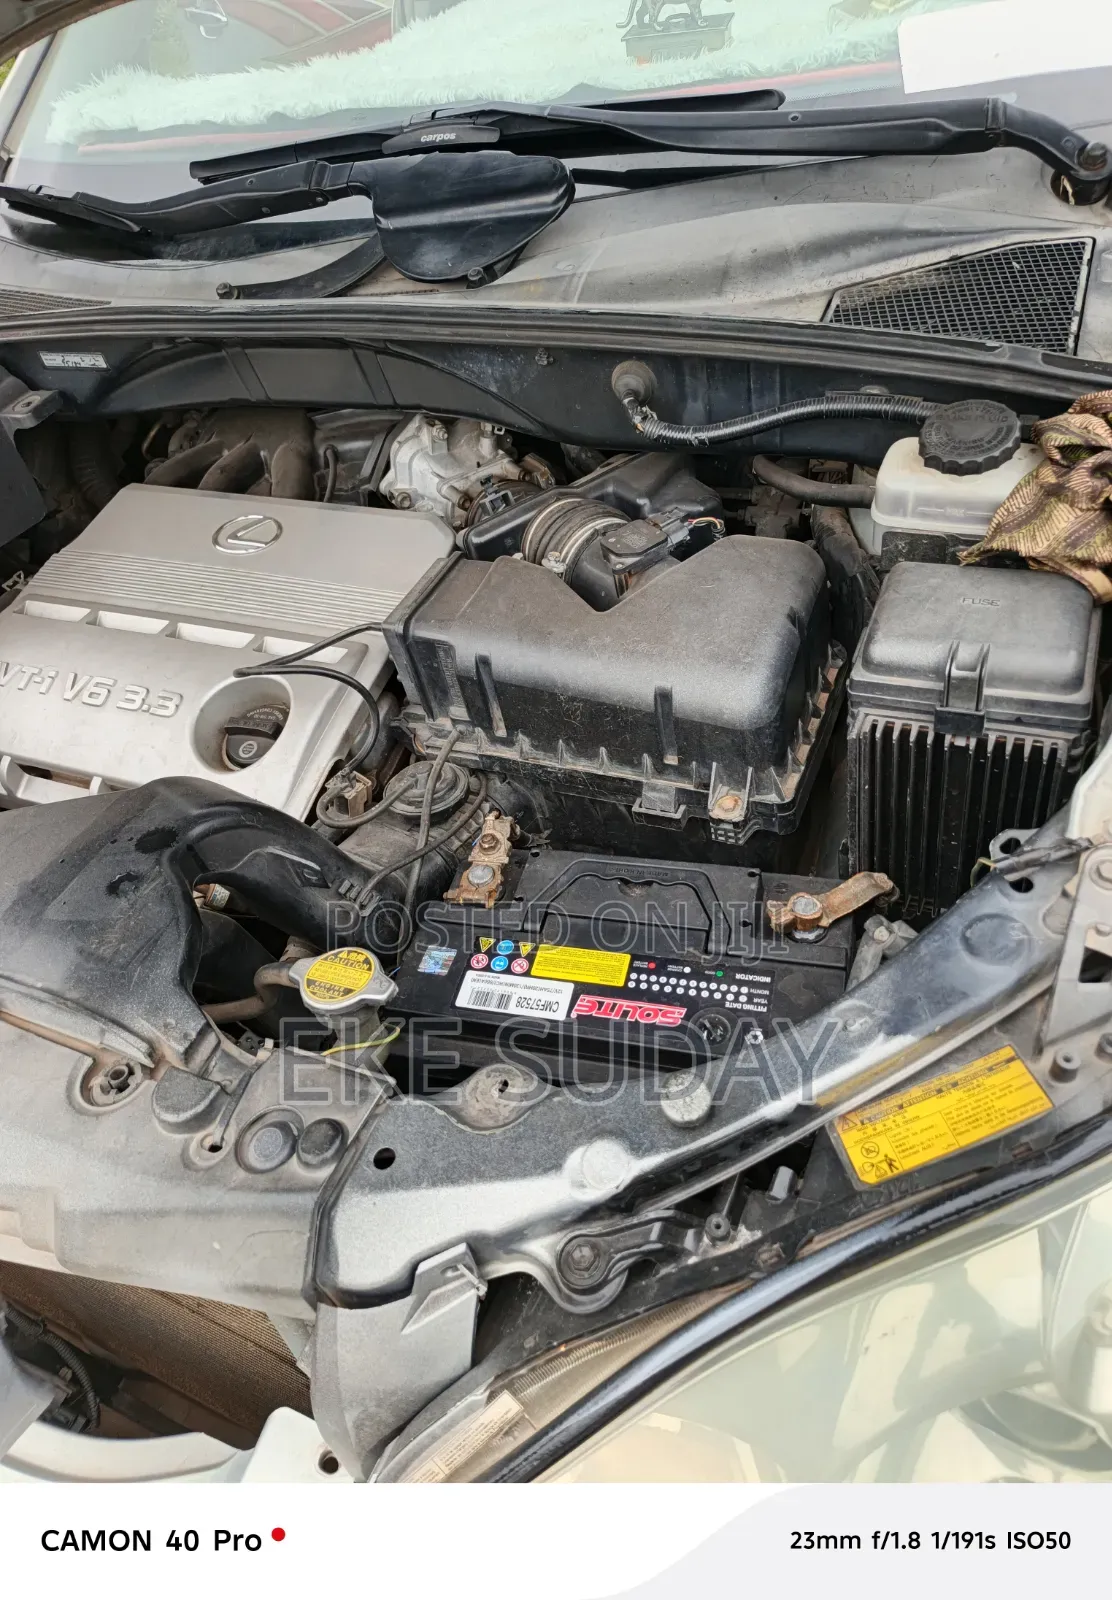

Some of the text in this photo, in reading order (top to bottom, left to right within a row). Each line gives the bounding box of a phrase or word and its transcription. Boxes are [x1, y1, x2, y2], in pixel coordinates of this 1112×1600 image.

[421, 132, 456, 142] carpos
[962, 597, 1001, 607] FUSE
[63, 672, 117, 708] V6
[116, 684, 183, 718] 3.3
[327, 955, 370, 970] CAUTION
[735, 973, 771, 983] INDICATOR
[309, 985, 345, 996] COOLANT
[315, 981, 345, 991] ENGINE
[515, 996, 560, 1013] CMF57528
[725, 1001, 767, 1012] FITTING DATE
[574, 996, 687, 1027] SOLITE
